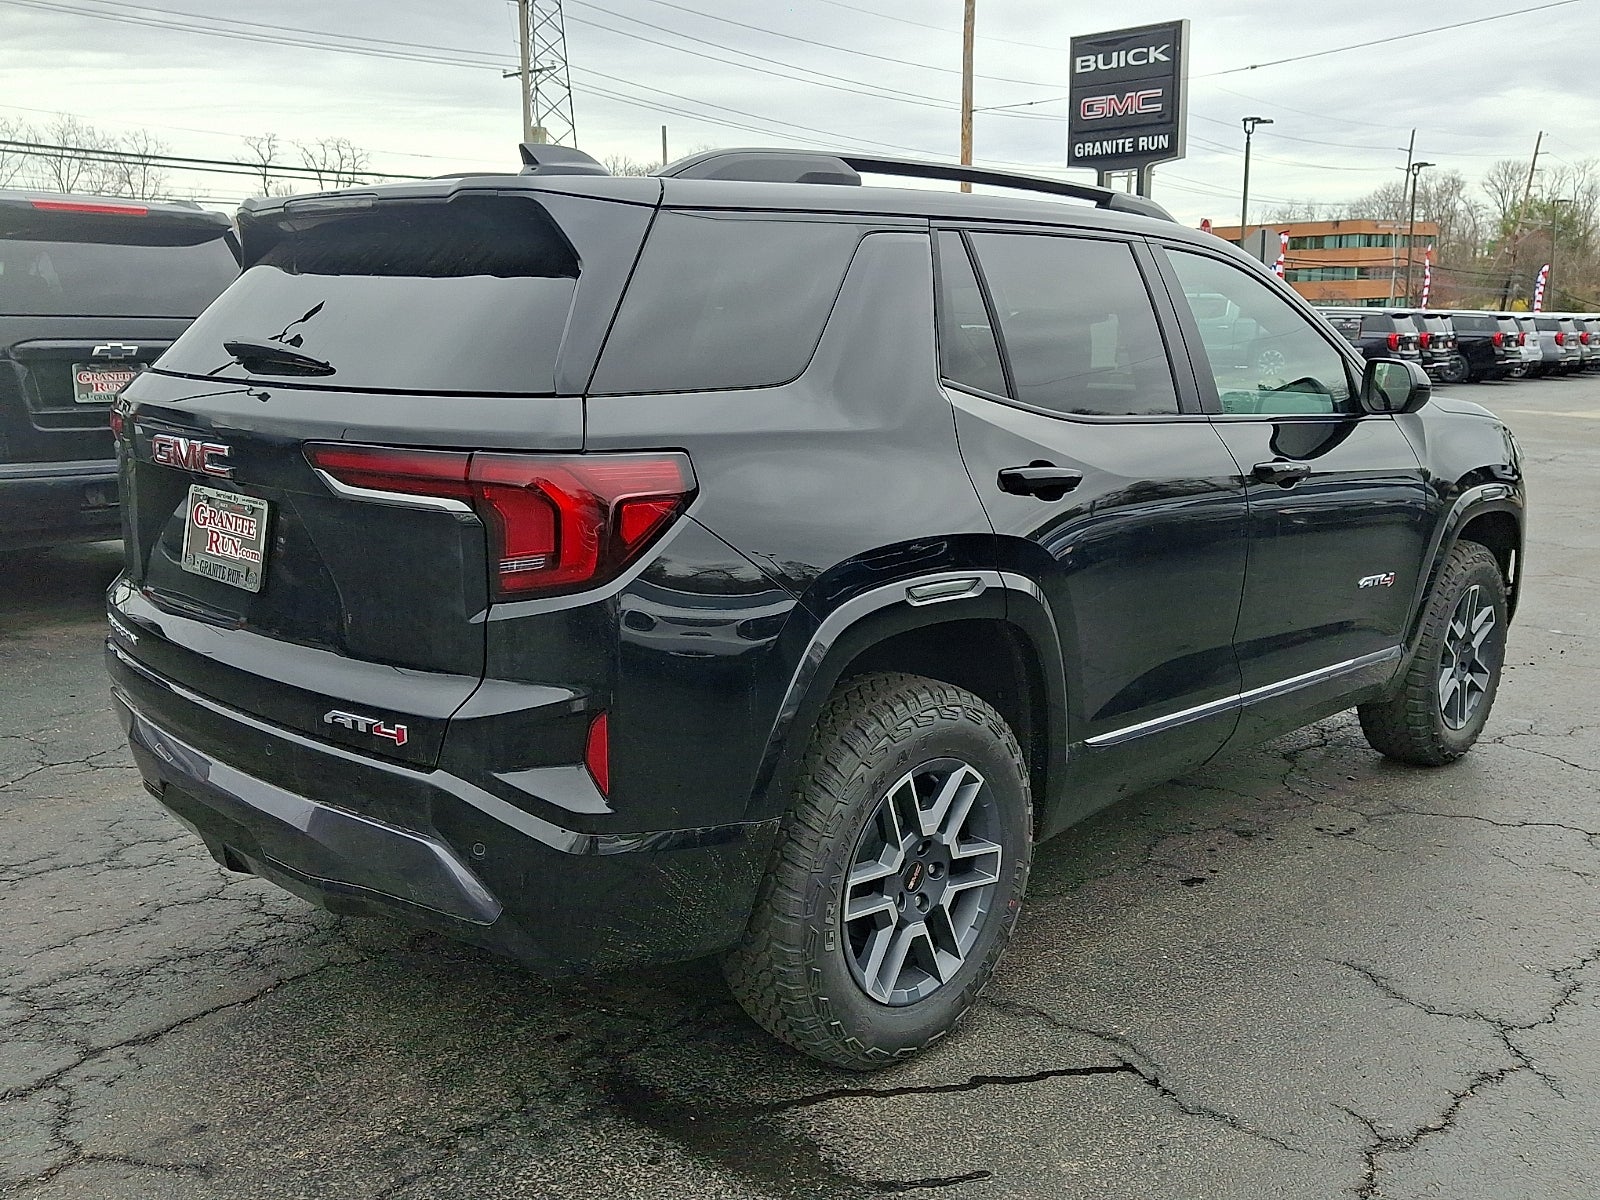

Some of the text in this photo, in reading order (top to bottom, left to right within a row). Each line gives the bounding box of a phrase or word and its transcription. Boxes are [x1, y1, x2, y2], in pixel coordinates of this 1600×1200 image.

[1075, 44, 1171, 74] BUICK
[1080, 88, 1163, 121] GMC
[1074, 134, 1170, 158] GRANITE RUN
[152, 433, 232, 478] GMC
[193, 502, 256, 538] GRANITE
[200, 560, 227, 581] GRANITE
[1358, 569, 1395, 588] AT4
[324, 710, 408, 746] AT4
